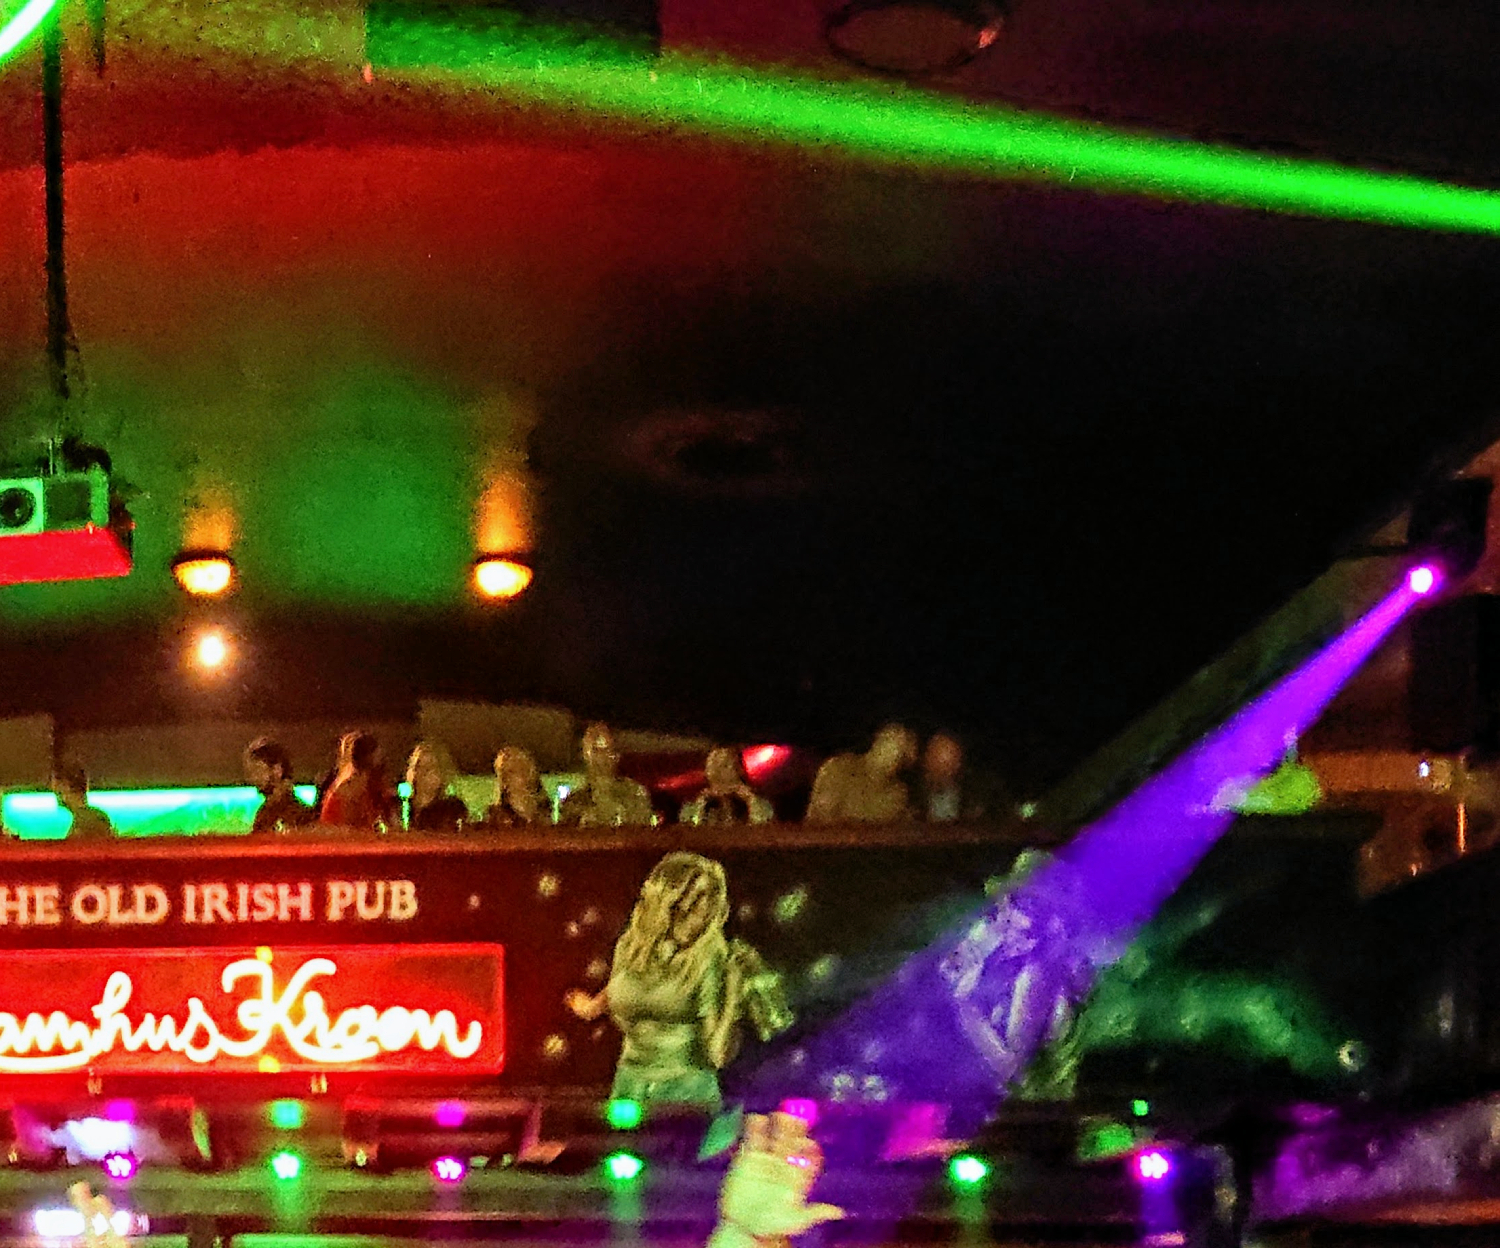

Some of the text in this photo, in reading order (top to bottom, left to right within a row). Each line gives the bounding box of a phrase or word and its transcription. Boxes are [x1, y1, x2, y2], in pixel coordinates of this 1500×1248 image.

[72, 883, 170, 925] OLD
[184, 881, 315, 923] IRISH
[326, 880, 418, 921] PUB
